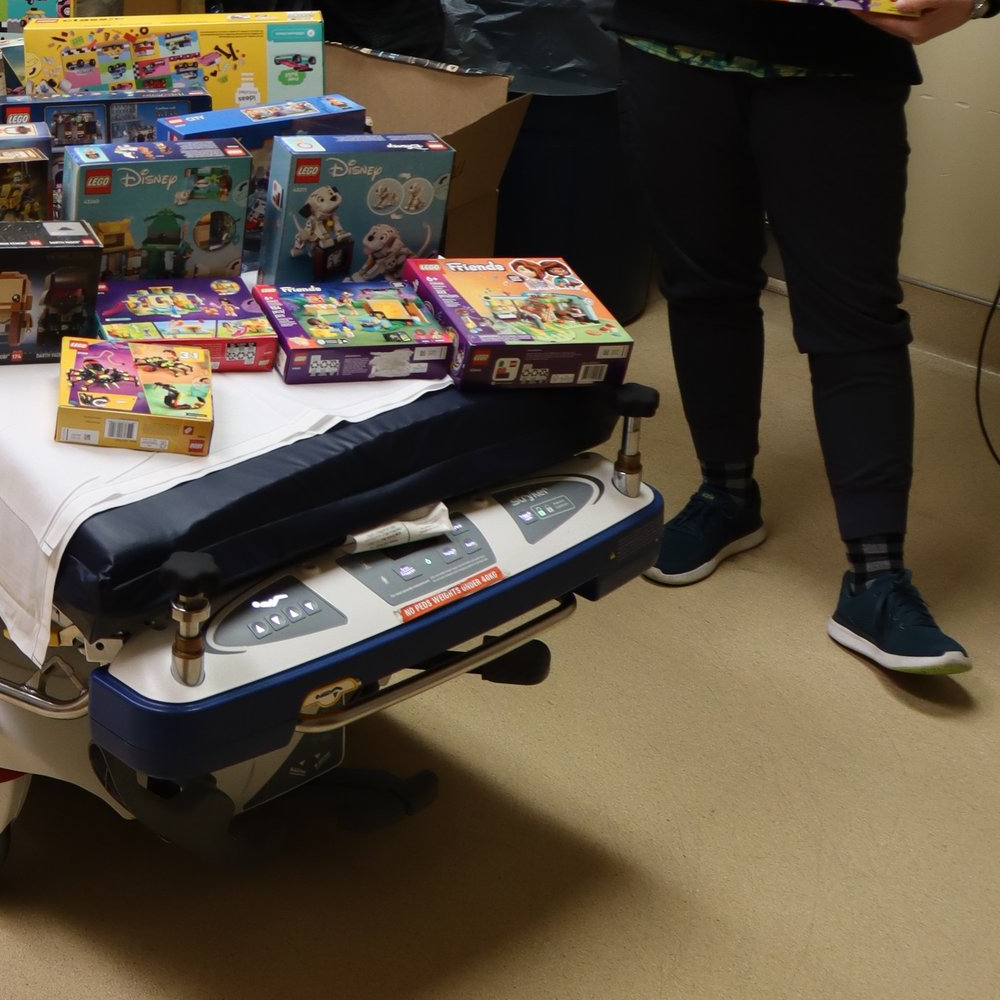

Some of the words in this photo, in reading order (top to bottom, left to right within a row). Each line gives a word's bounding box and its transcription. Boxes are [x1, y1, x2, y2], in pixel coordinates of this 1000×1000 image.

[7, 113, 30, 124] LEGO
[297, 165, 319, 175] LEGO
[87, 177, 110, 187] LEGO
[446, 261, 505, 271] Friends
[280, 285, 322, 293] Friends
[404, 606, 415, 617] NO
[415, 600, 432, 613] PEDS
[432, 587, 461, 604] WEIGHTS
[461, 578, 482, 592] UNDER
